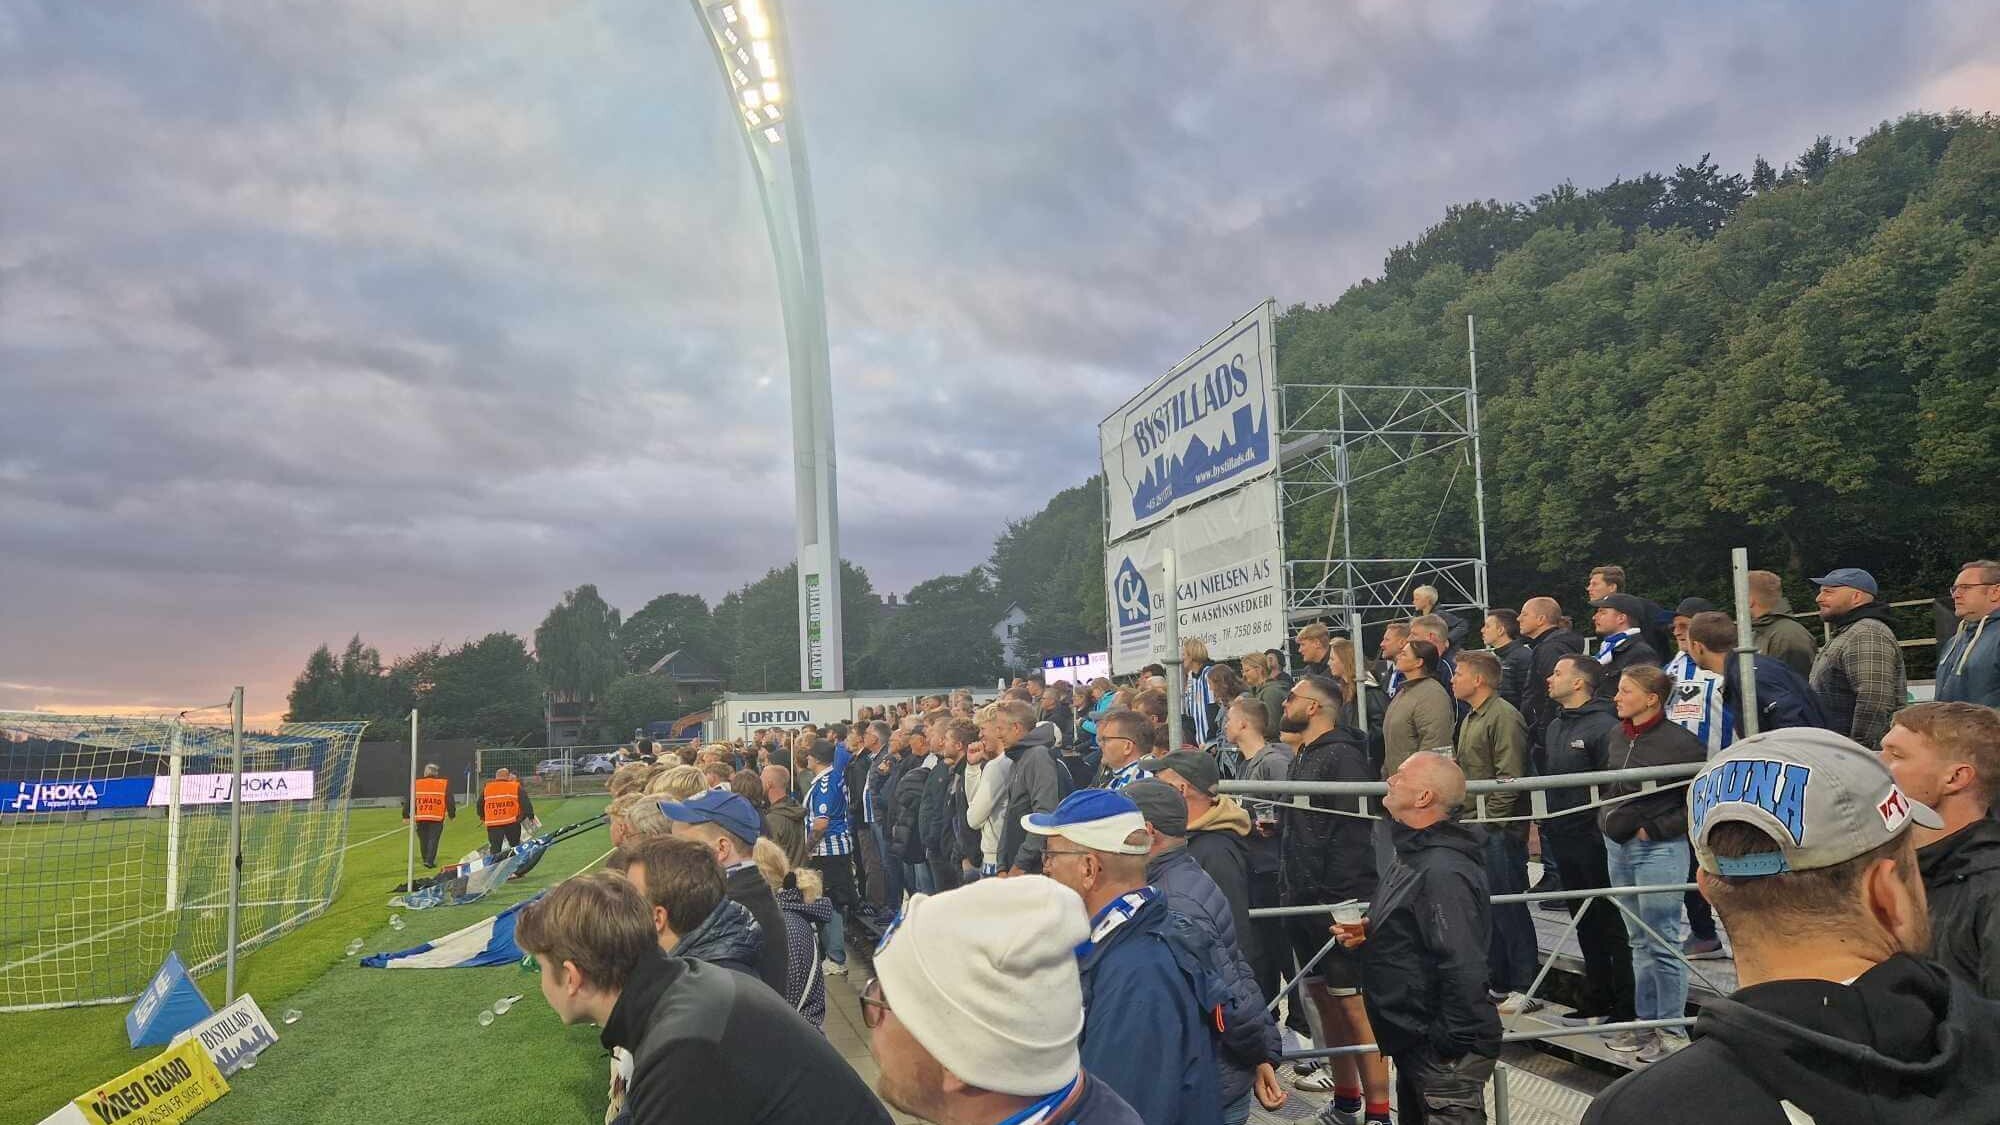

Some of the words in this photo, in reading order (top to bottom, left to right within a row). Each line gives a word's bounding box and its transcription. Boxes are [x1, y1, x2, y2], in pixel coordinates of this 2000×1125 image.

[1133, 353, 1248, 457] BYSTILLADS
[1201, 566, 1249, 595] NIELSEN
[1253, 558, 1270, 581] A/S
[1191, 593, 1272, 624] MASKINSNEDKERI
[1234, 625, 1250, 639] 7550
[737, 710, 810, 724] JORTON
[42, 783, 98, 801] HOKA
[240, 777, 288, 791] HOKA
[200, 1006, 253, 1050] BYSTILLADS
[92, 1081, 150, 1125] VIDEO
[143, 1056, 192, 1098] GUARD
